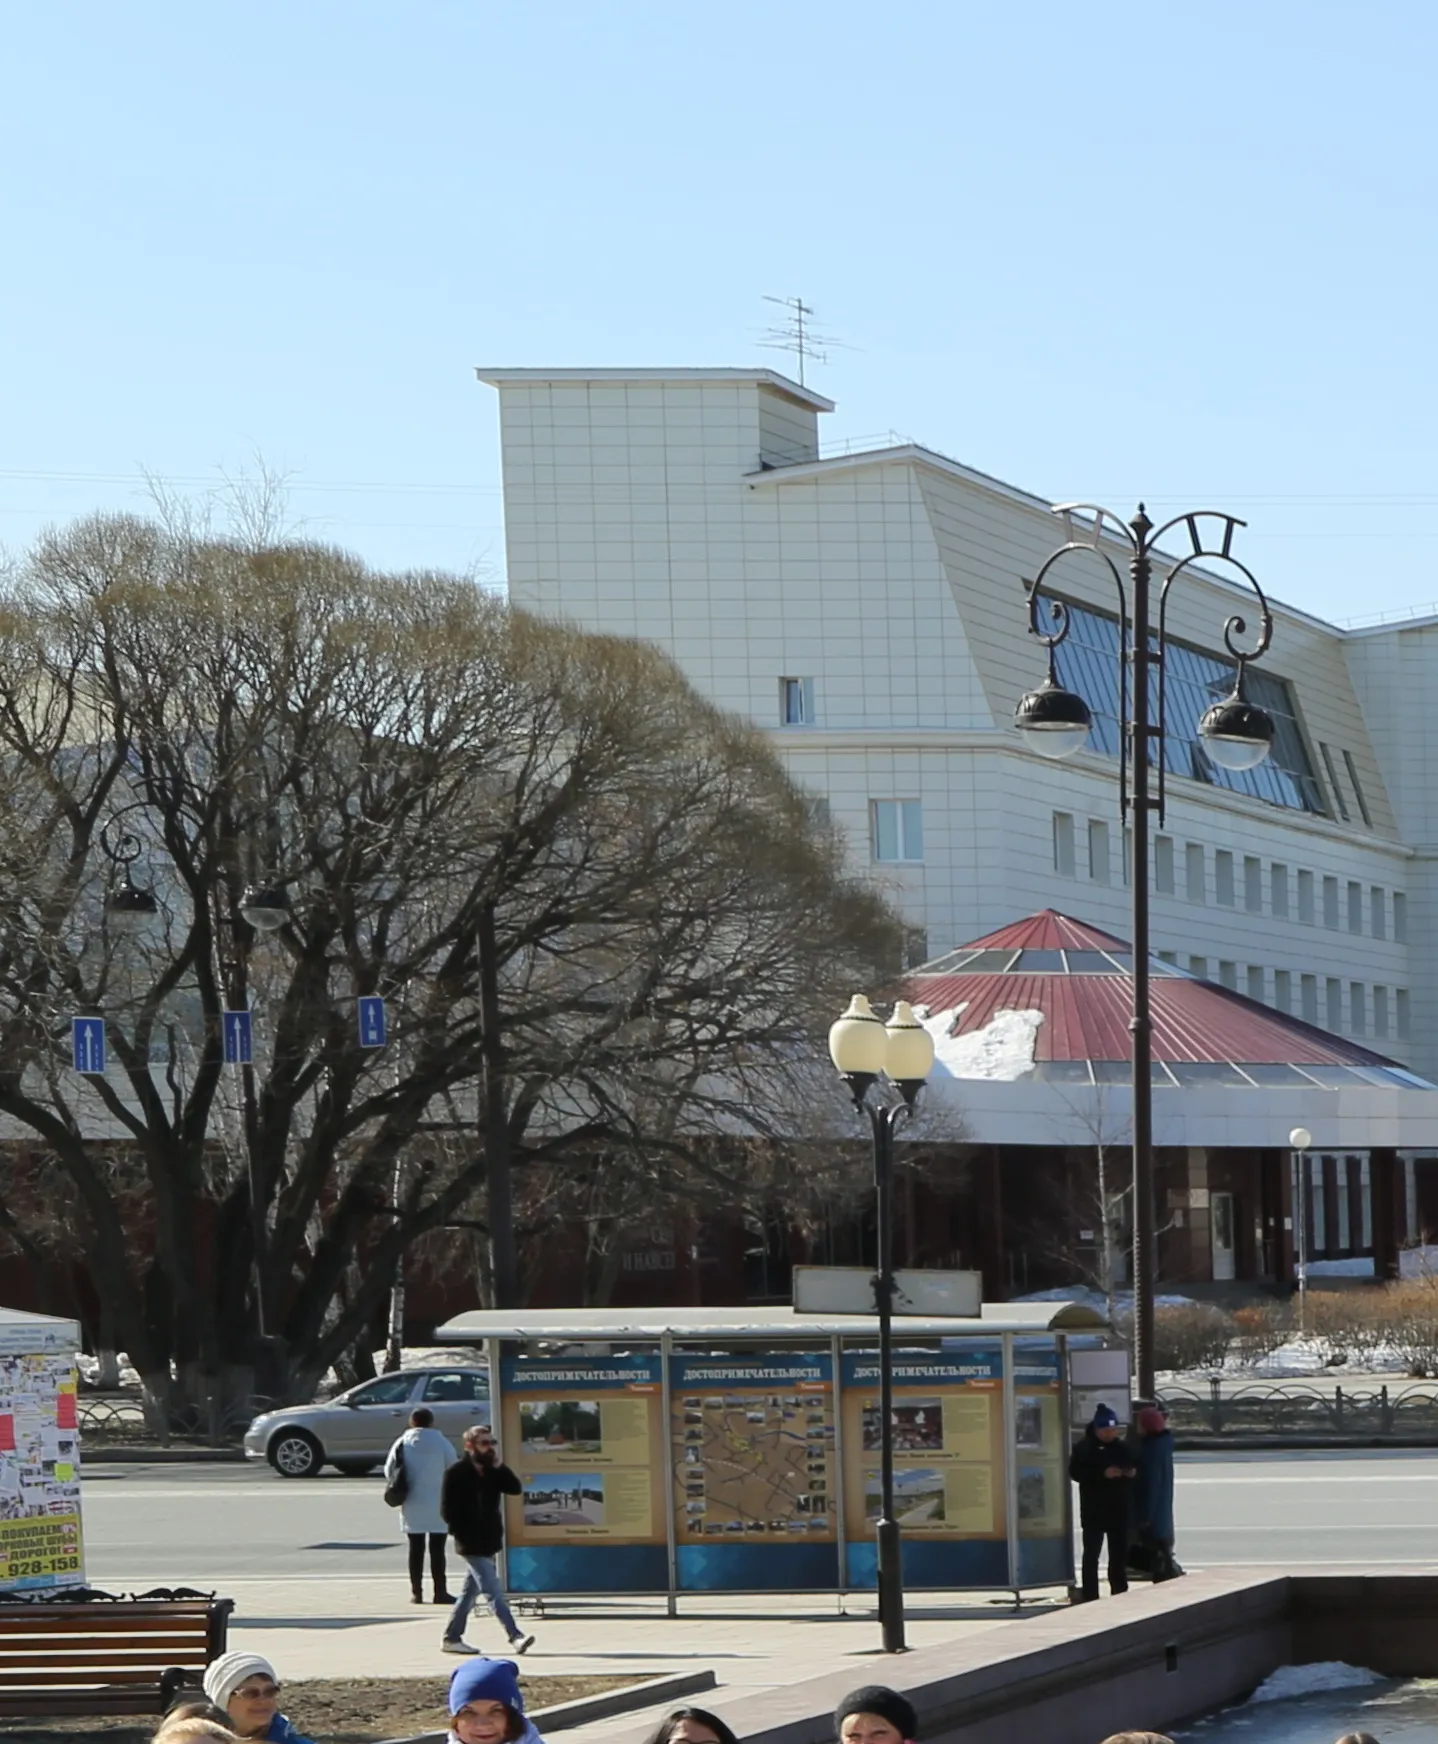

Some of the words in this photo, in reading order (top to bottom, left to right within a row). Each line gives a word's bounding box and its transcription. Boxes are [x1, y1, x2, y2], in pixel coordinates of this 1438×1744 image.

[512, 1369, 652, 1383] ДОСТОПРИМЕЧАТЕЛЬНОСТИ
[683, 1367, 822, 1381] ДОСТОПРИМЕЧАТЕЛЬНОСТИ
[853, 1365, 992, 1379] ДОСТРИМЕЧАТЕЛЬНОСТИ
[8, 1556, 79, 1576] 928-158
